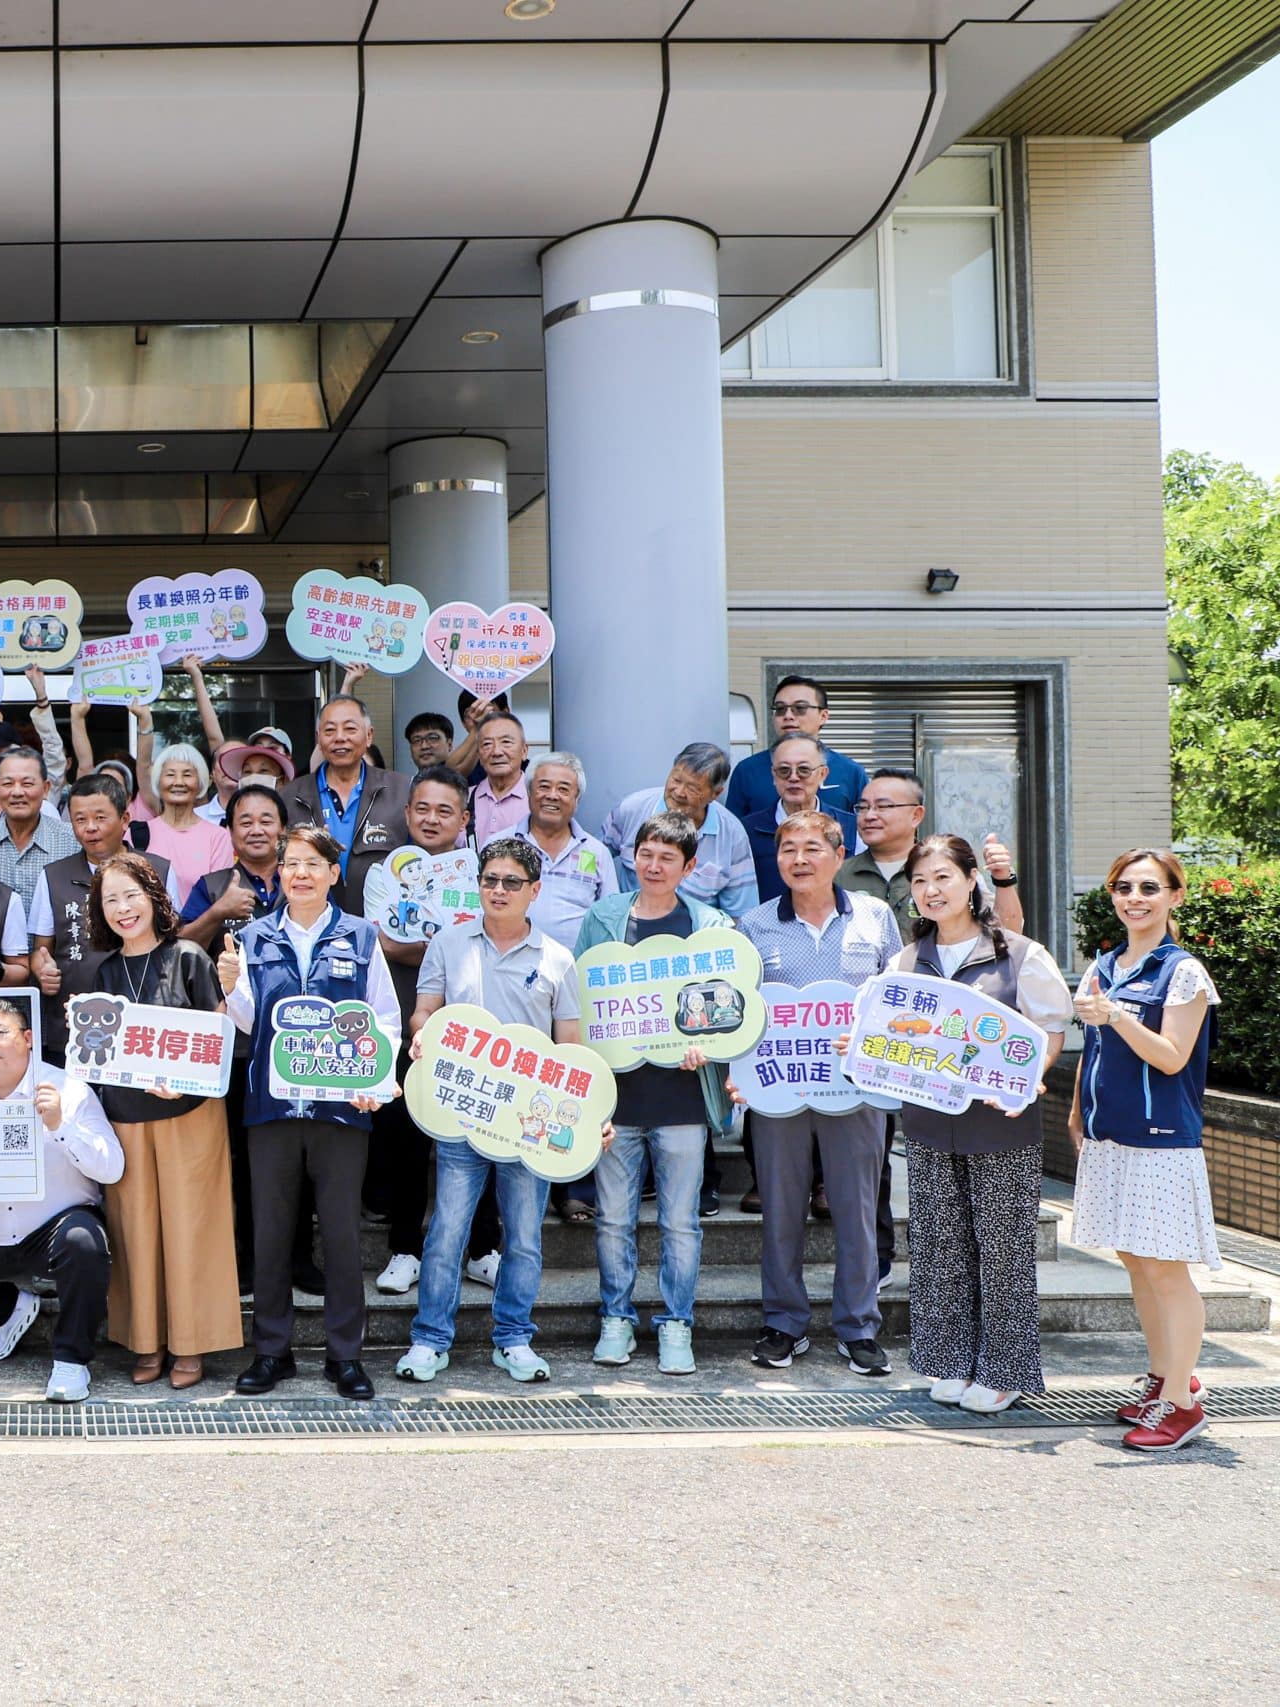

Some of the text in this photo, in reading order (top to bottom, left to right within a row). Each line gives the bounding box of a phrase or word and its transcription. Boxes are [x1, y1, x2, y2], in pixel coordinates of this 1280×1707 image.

[138, 585, 249, 610] 長輩換照分年齡
[307, 585, 417, 619] 高齡換照先講習
[145, 612, 199, 629] 定期換照
[306, 608, 362, 629] 安全駕駛
[482, 625, 541, 637] 行人路權
[310, 622, 352, 642] 更放心
[442, 889, 480, 909] 騎車
[586, 948, 736, 988] 高齡自願繳駕照
[592, 994, 664, 1020] TPASS
[882, 984, 938, 1015] 車輛
[767, 1002, 855, 1028] 早70來
[588, 1020, 671, 1041] 陪您四處跑
[123, 1026, 224, 1065] 我停讓
[757, 1038, 832, 1056] 寶島自在
[863, 1035, 961, 1075] 禮讓行人
[291, 1059, 376, 1076] 行人安全行
[441, 1021, 593, 1099] 滿70換新照
[433, 1058, 516, 1104] 體檢上課
[755, 1059, 831, 1088] 趴趴走
[964, 1065, 1028, 1094] 優先行
[435, 1084, 497, 1124] 平安到
